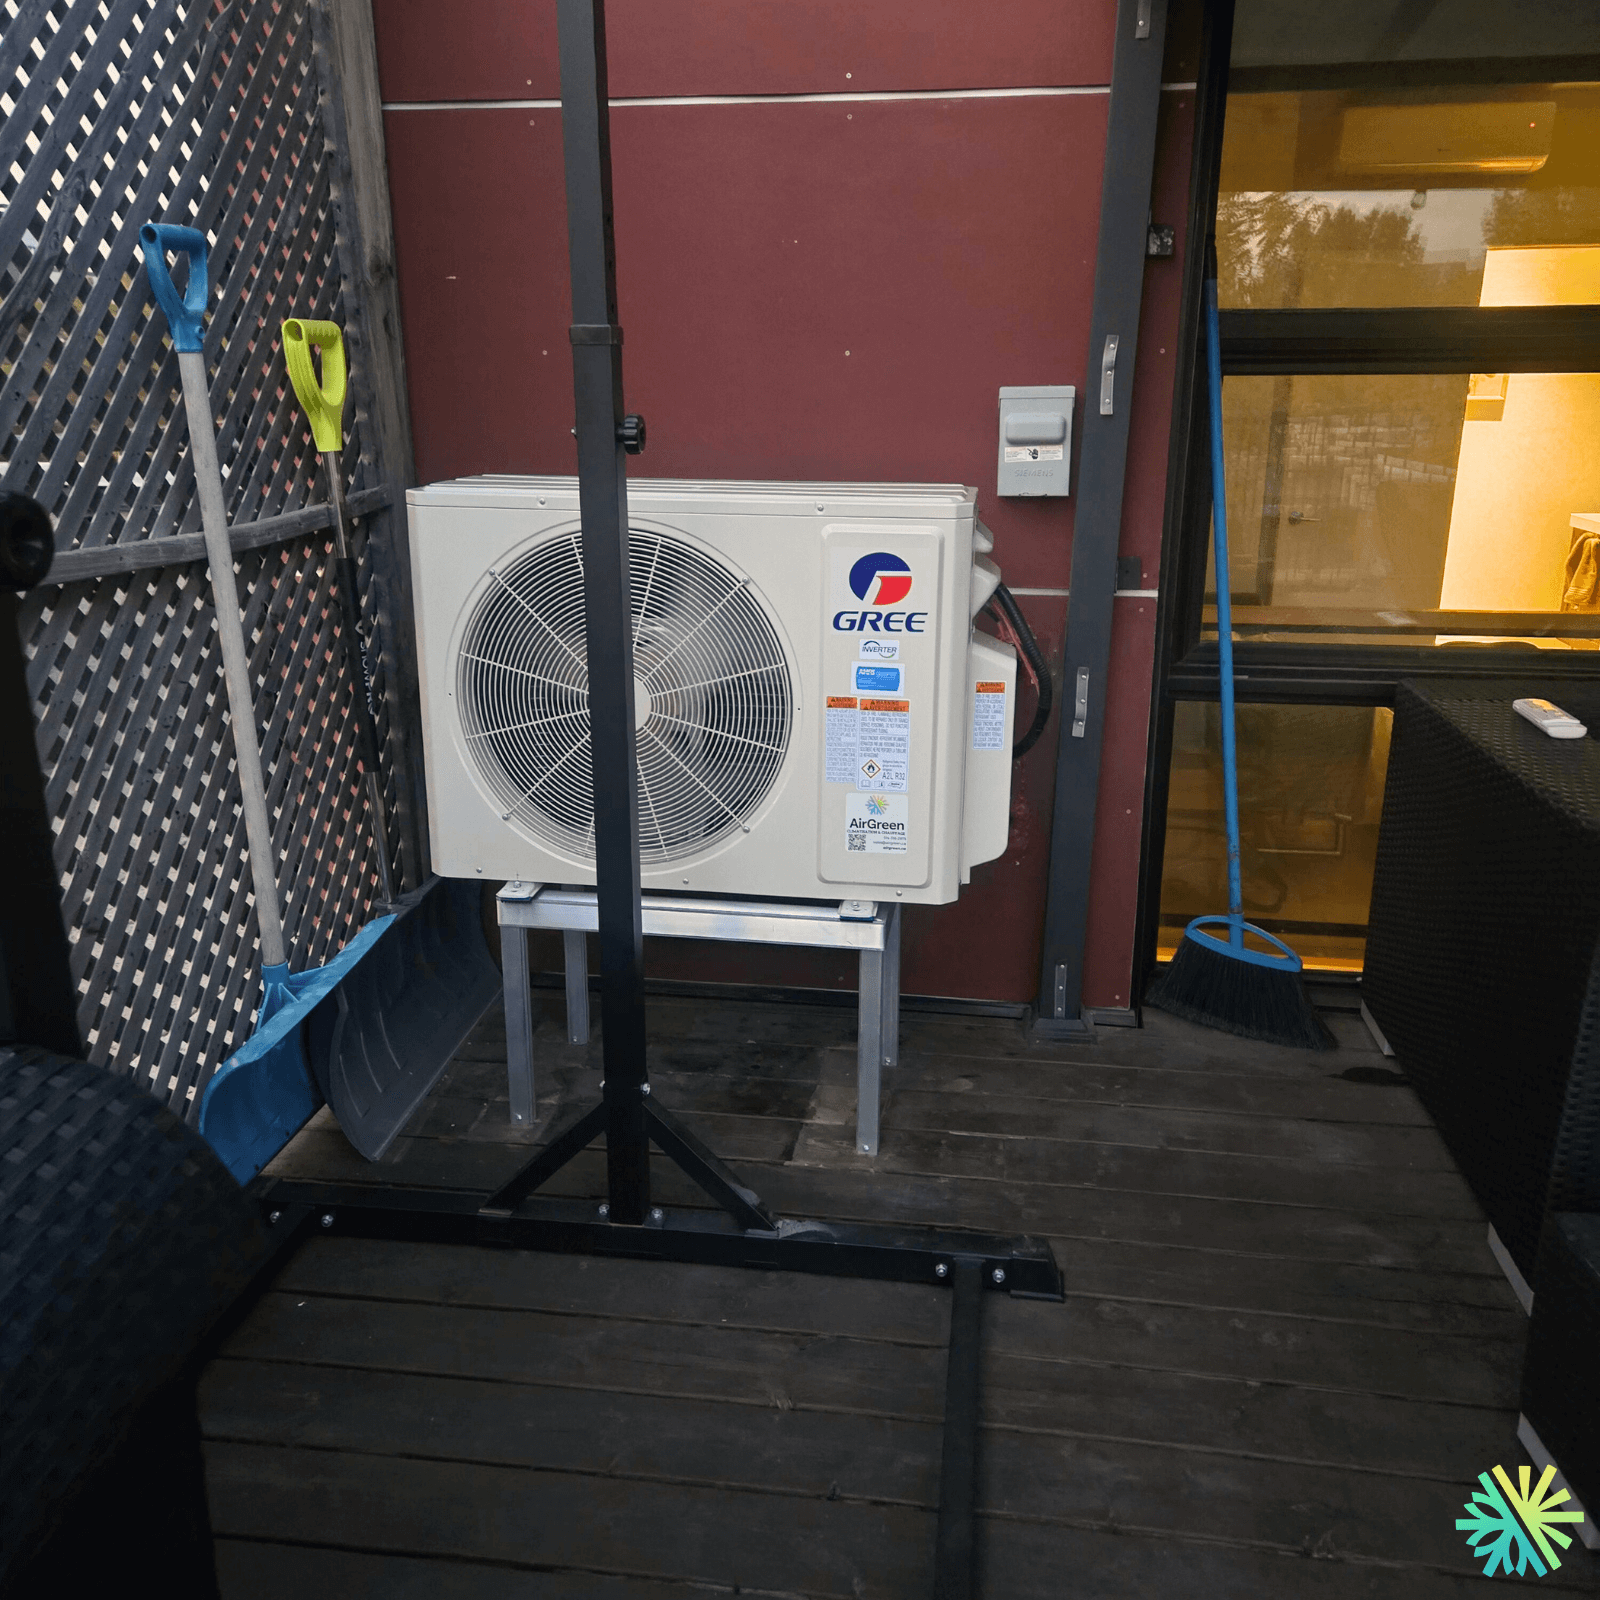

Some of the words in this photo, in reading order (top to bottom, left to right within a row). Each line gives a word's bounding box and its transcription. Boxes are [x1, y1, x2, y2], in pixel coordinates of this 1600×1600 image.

[1014, 468, 1054, 477] SIEMENS
[832, 611, 928, 633] GREE
[861, 646, 897, 654] INVERTER
[882, 772, 893, 780] A2L
[895, 772, 905, 780] R32
[850, 818, 905, 830] AirGreen
